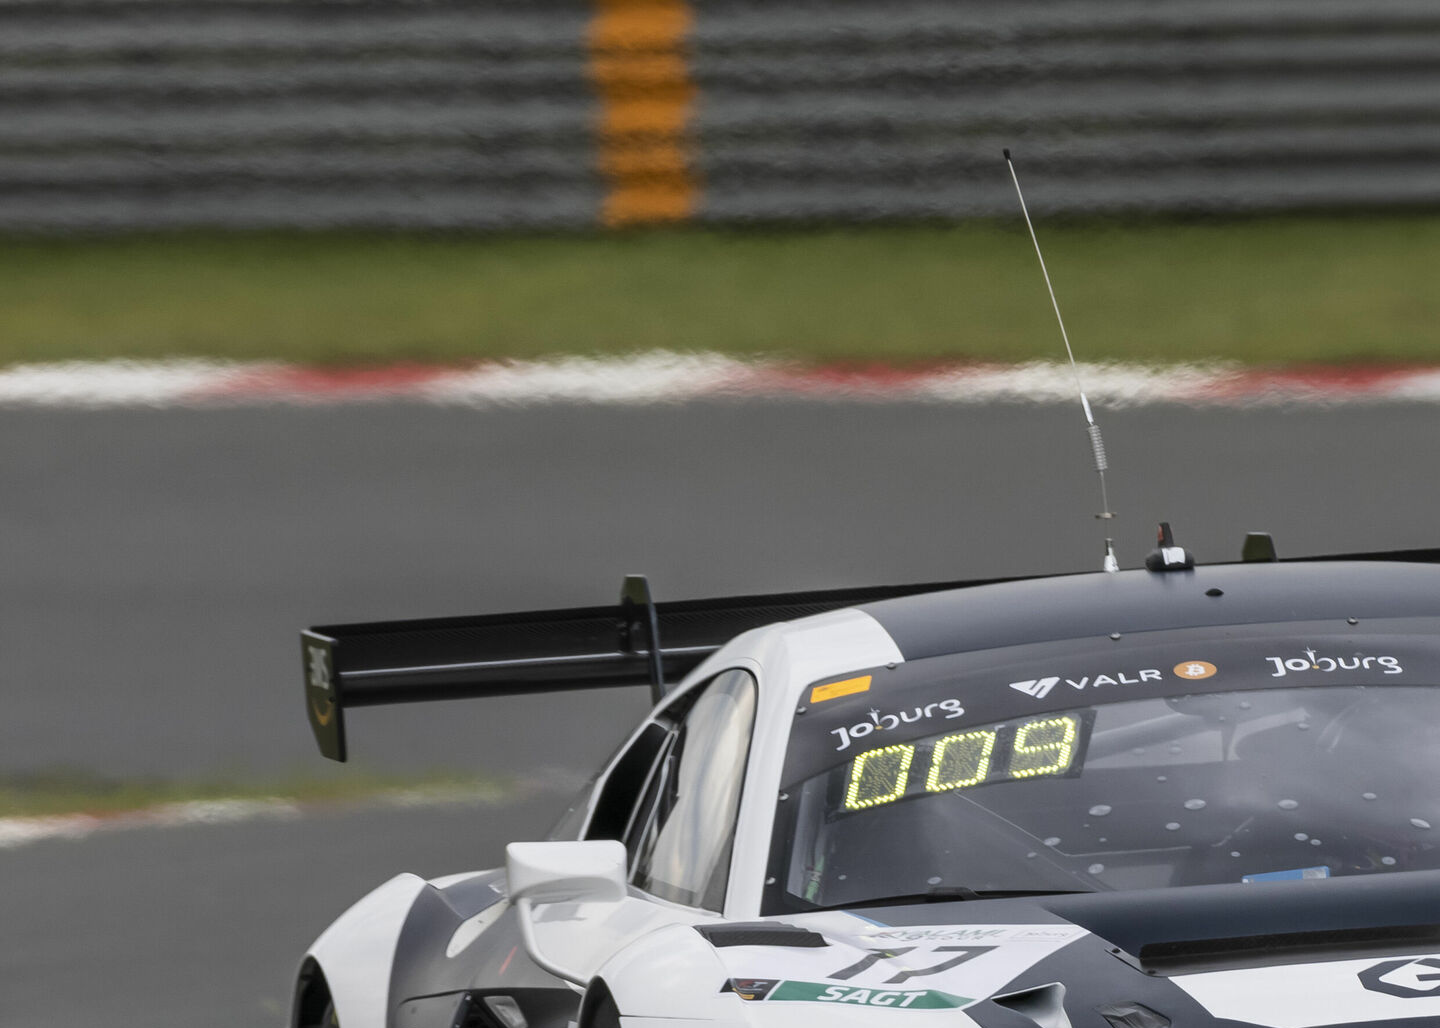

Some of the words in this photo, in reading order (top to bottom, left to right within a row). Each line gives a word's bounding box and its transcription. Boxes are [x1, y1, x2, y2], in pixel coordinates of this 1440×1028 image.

[1266, 647, 1403, 678] Joburg
[1065, 669, 1163, 690] VALR
[831, 699, 965, 751] Joburg
[844, 716, 1076, 810] 009
[817, 986, 928, 1008] SAGT
